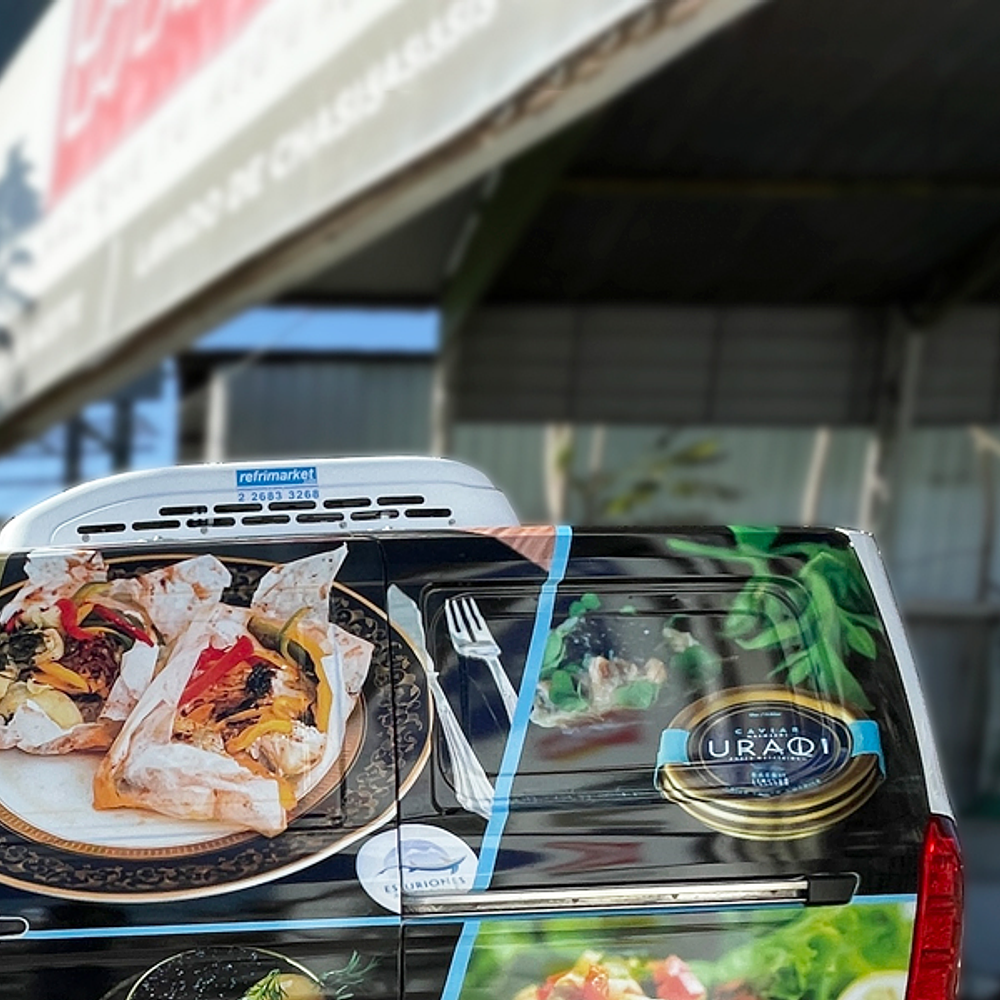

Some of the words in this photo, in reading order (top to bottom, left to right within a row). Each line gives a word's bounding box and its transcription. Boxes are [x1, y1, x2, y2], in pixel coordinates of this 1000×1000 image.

[239, 468, 315, 483] refrimarket
[707, 736, 830, 758] URAQI
[384, 876, 466, 894] ESURIONES
